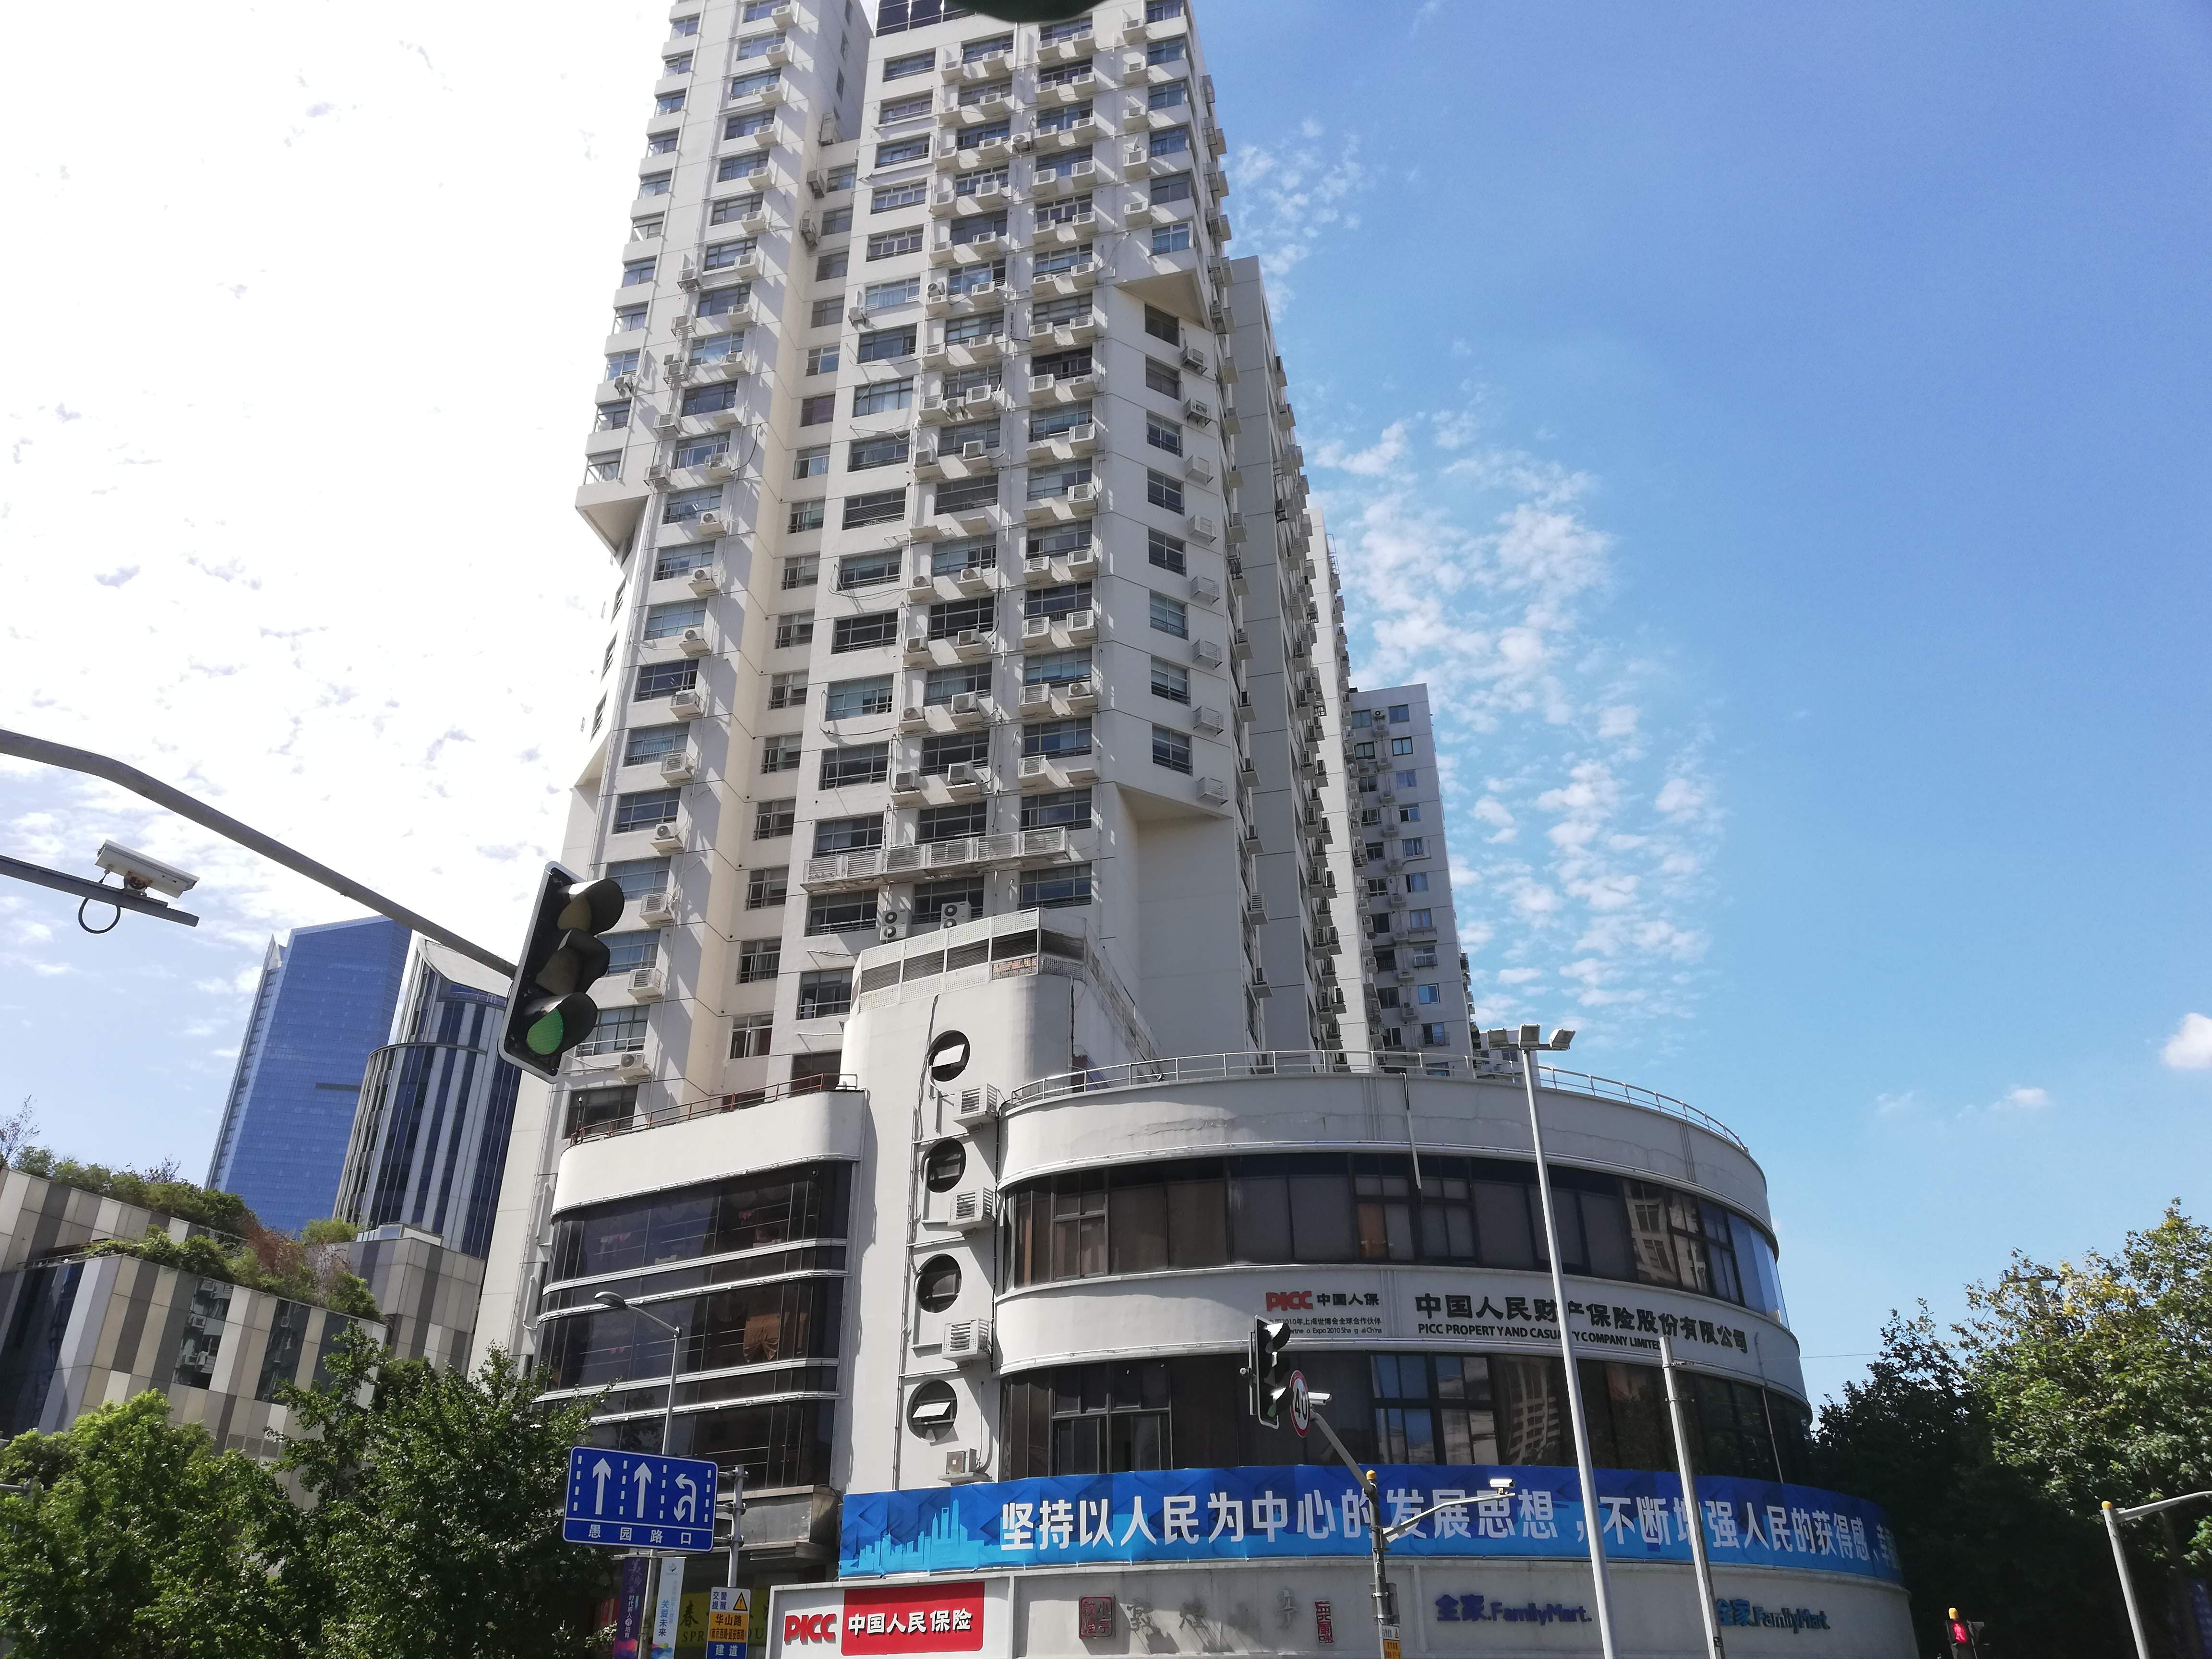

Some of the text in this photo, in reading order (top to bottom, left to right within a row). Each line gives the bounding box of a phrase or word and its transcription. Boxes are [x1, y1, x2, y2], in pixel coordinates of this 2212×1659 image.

[1266, 1290, 1313, 1311] PICC
[1317, 1293, 1379, 1307] 中国人保
[1418, 1323, 1443, 1334] PICC
[1295, 1388, 1310, 1420] 40
[588, 1524, 692, 1545] 愚园路口
[712, 1591, 727, 1601] 交警
[1435, 1594, 1488, 1622] 全家
[658, 1599, 670, 1637] 关爱未来
[715, 1613, 742, 1626] 华山路
[848, 1608, 973, 1636] 中国人民保险
[1490, 1602, 1587, 1626] FamilyMart
[1715, 1598, 1755, 1626] 全家
[1753, 1606, 1831, 1634] FamilyMart
[784, 1612, 837, 1645] PICC
